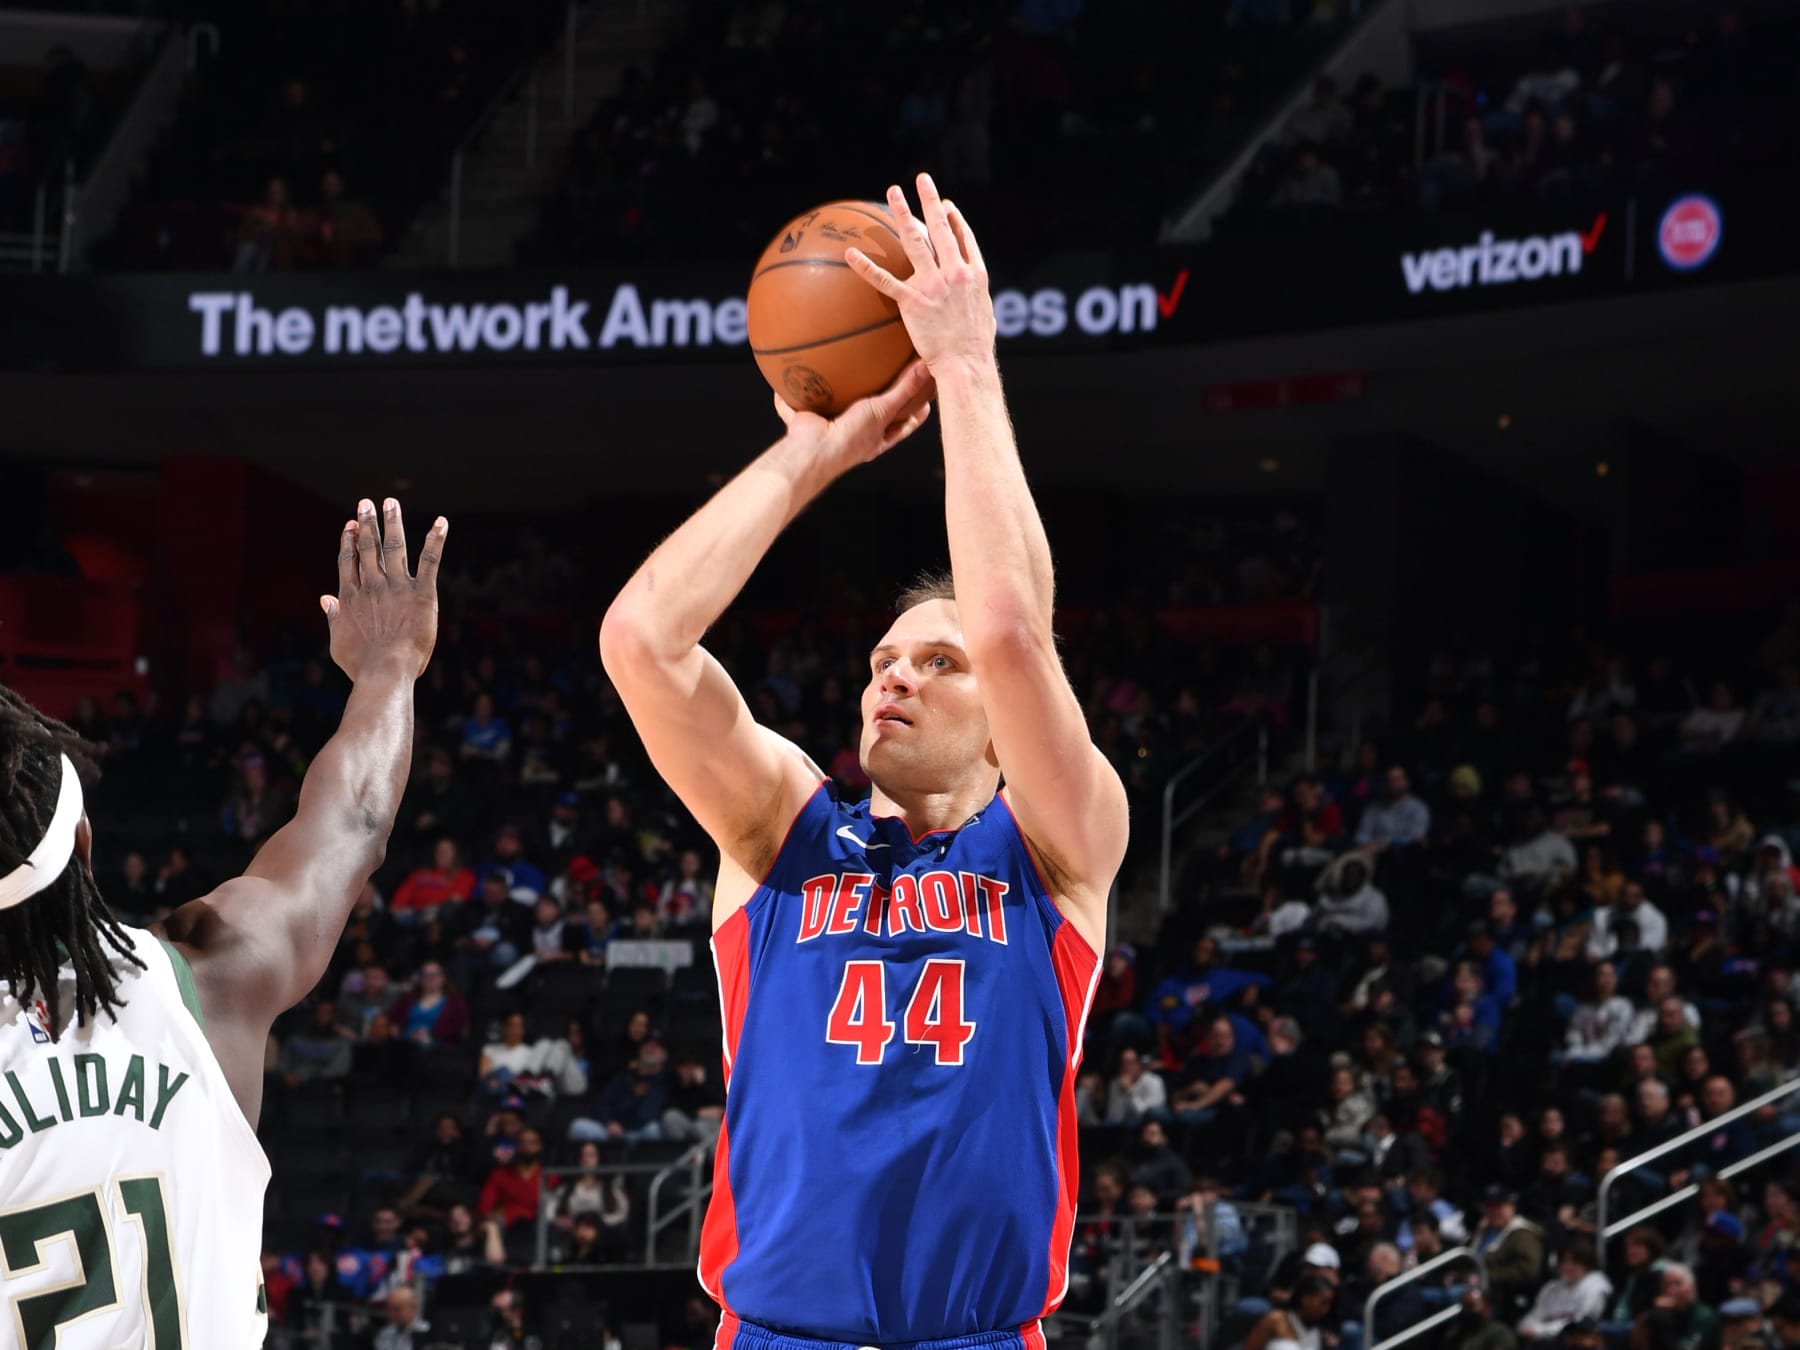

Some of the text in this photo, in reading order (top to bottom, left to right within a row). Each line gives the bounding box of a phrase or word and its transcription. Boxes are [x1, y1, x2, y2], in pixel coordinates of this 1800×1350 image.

[1402, 231, 1582, 292] verizon
[190, 293, 314, 356] The
[324, 287, 589, 354] network
[1076, 283, 1157, 334] on
[796, 871, 1009, 945] DETROIT
[825, 959, 976, 1066] 44
